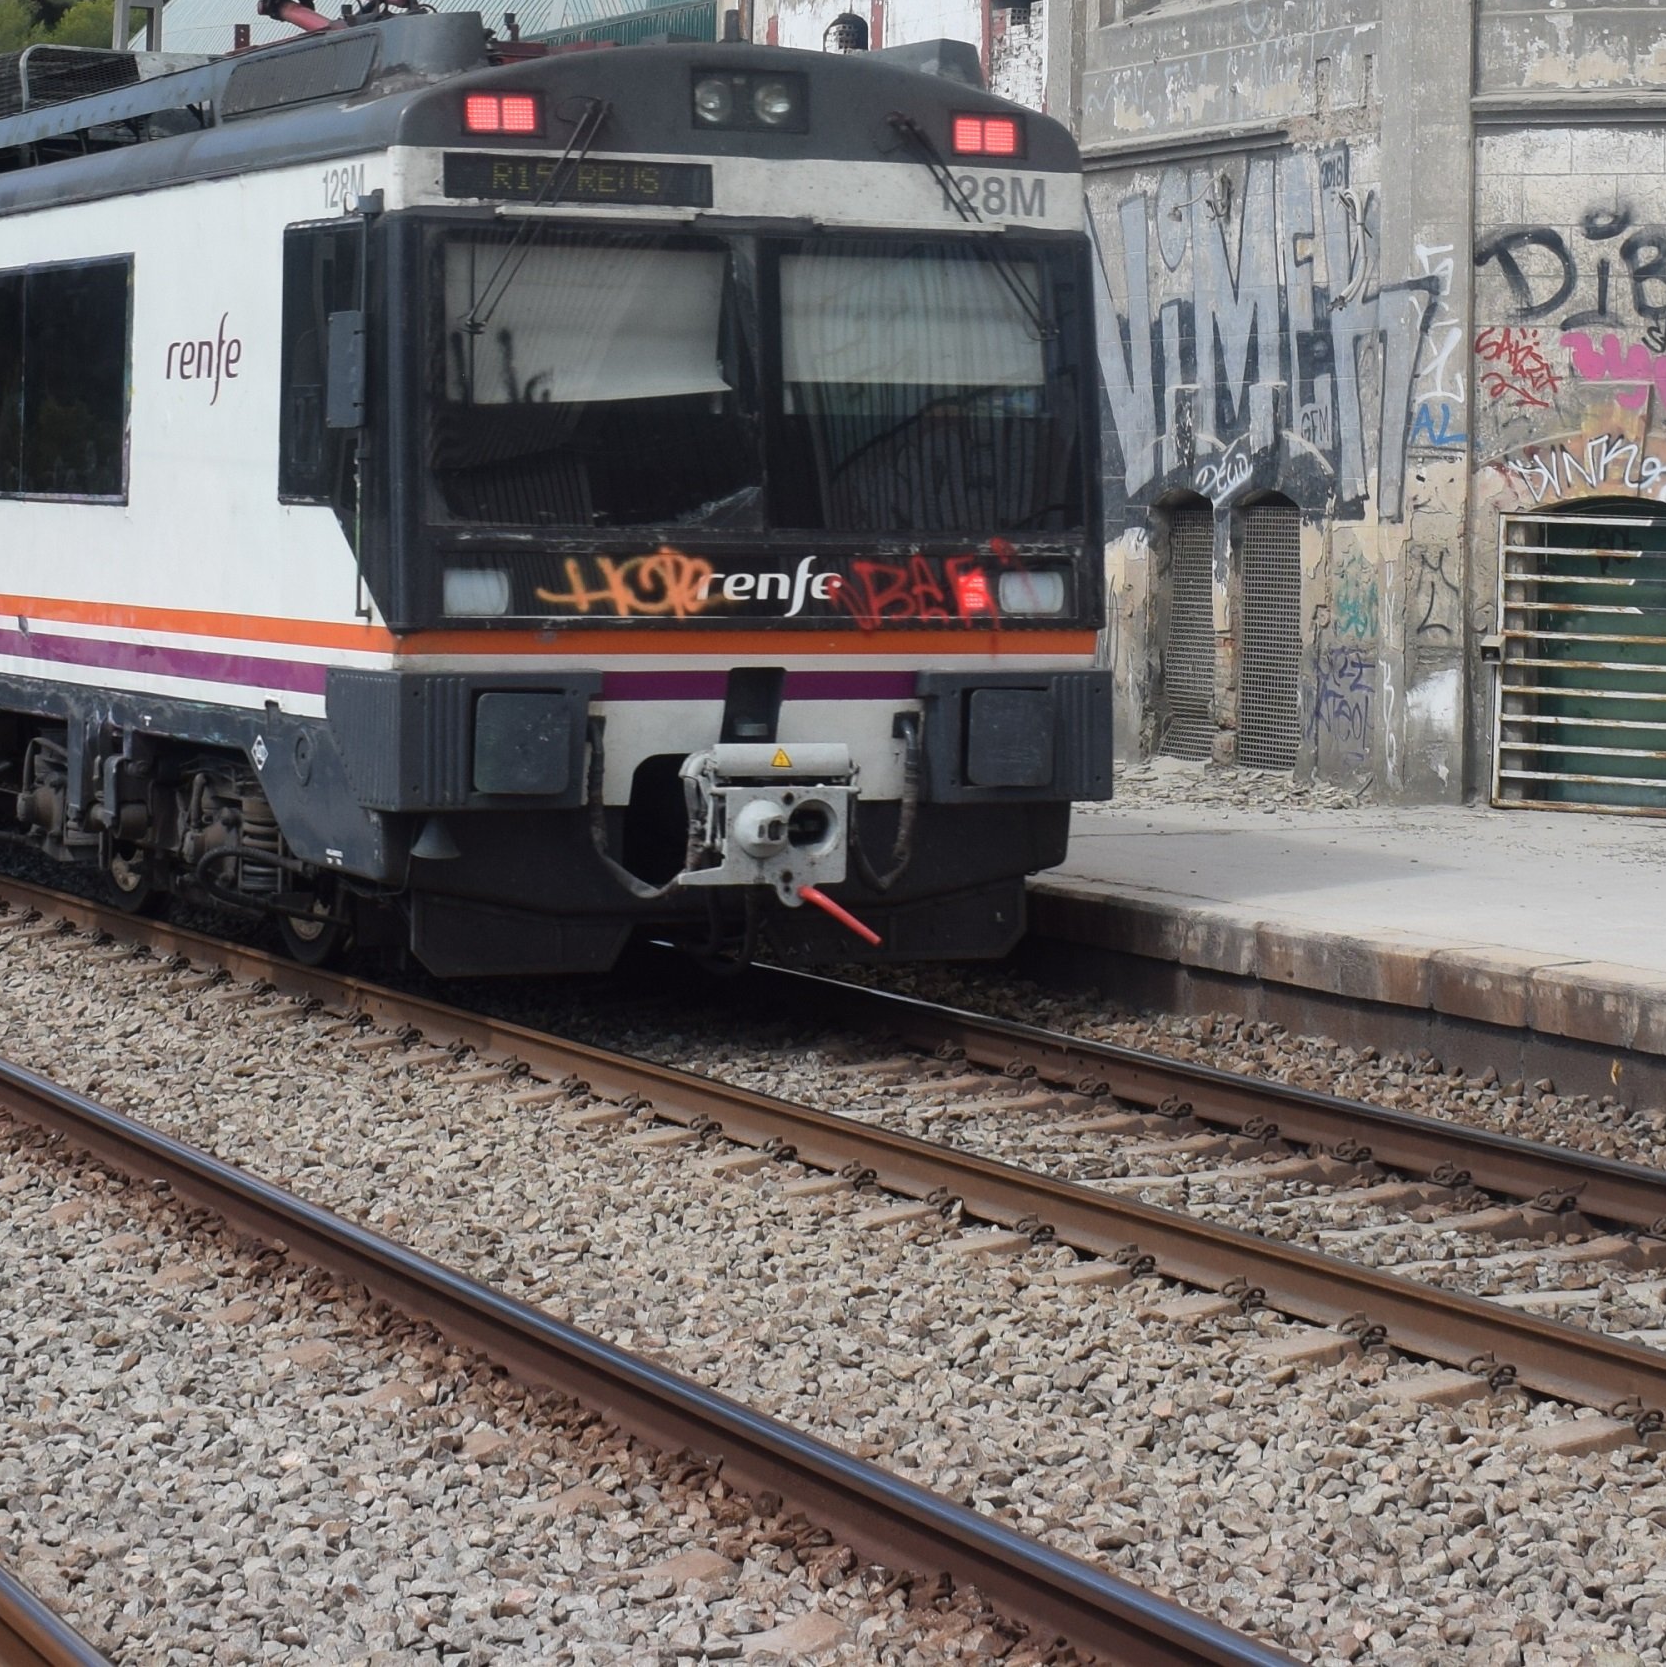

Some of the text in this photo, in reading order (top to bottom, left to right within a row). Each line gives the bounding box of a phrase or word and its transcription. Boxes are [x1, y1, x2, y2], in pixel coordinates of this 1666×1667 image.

[322, 163, 365, 209] 128M
[576, 165, 660, 194] REUS
[936, 173, 1046, 218] 128M
[165, 311, 242, 407] renfe
[696, 555, 843, 618] renfe
